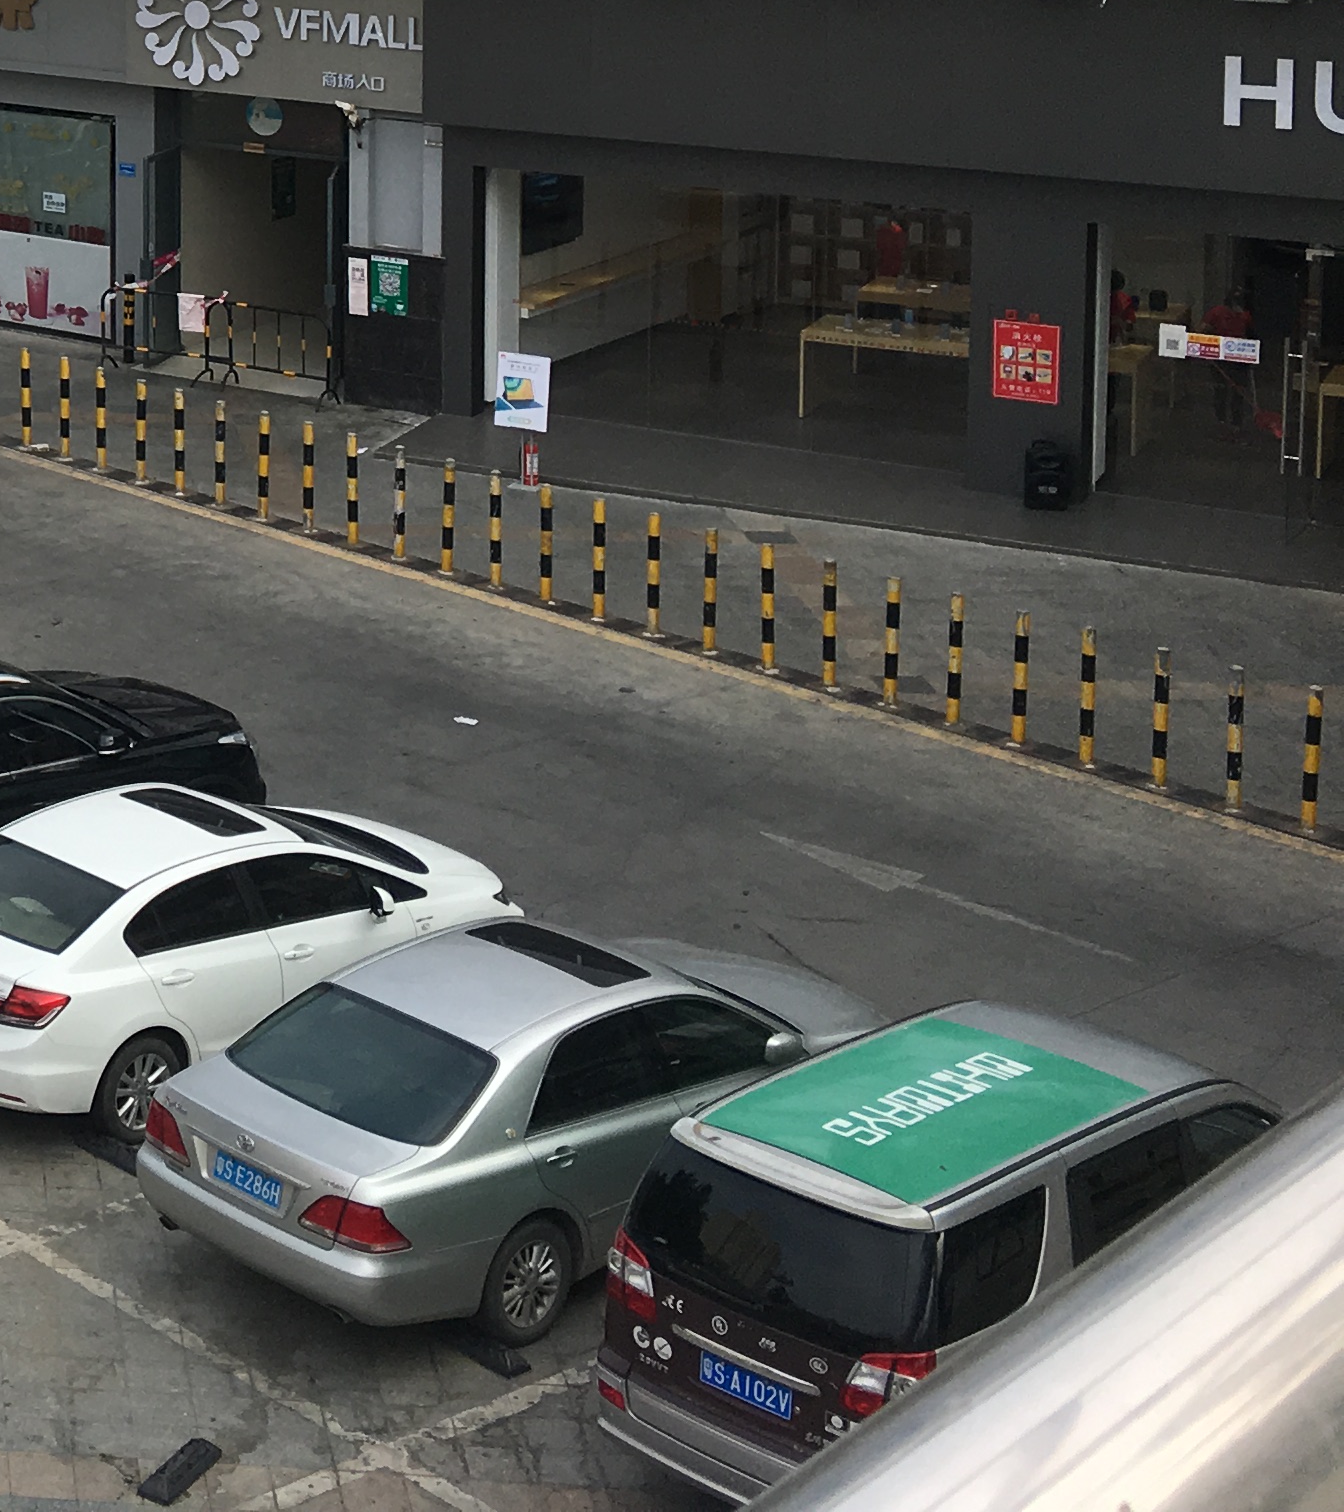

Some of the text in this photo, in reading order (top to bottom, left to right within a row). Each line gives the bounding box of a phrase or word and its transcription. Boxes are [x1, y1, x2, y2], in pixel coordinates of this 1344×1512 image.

[274, 6, 423, 51] VFMALL
[322, 71, 385, 92] 商场入口
[34, 220, 64, 236] TEA
